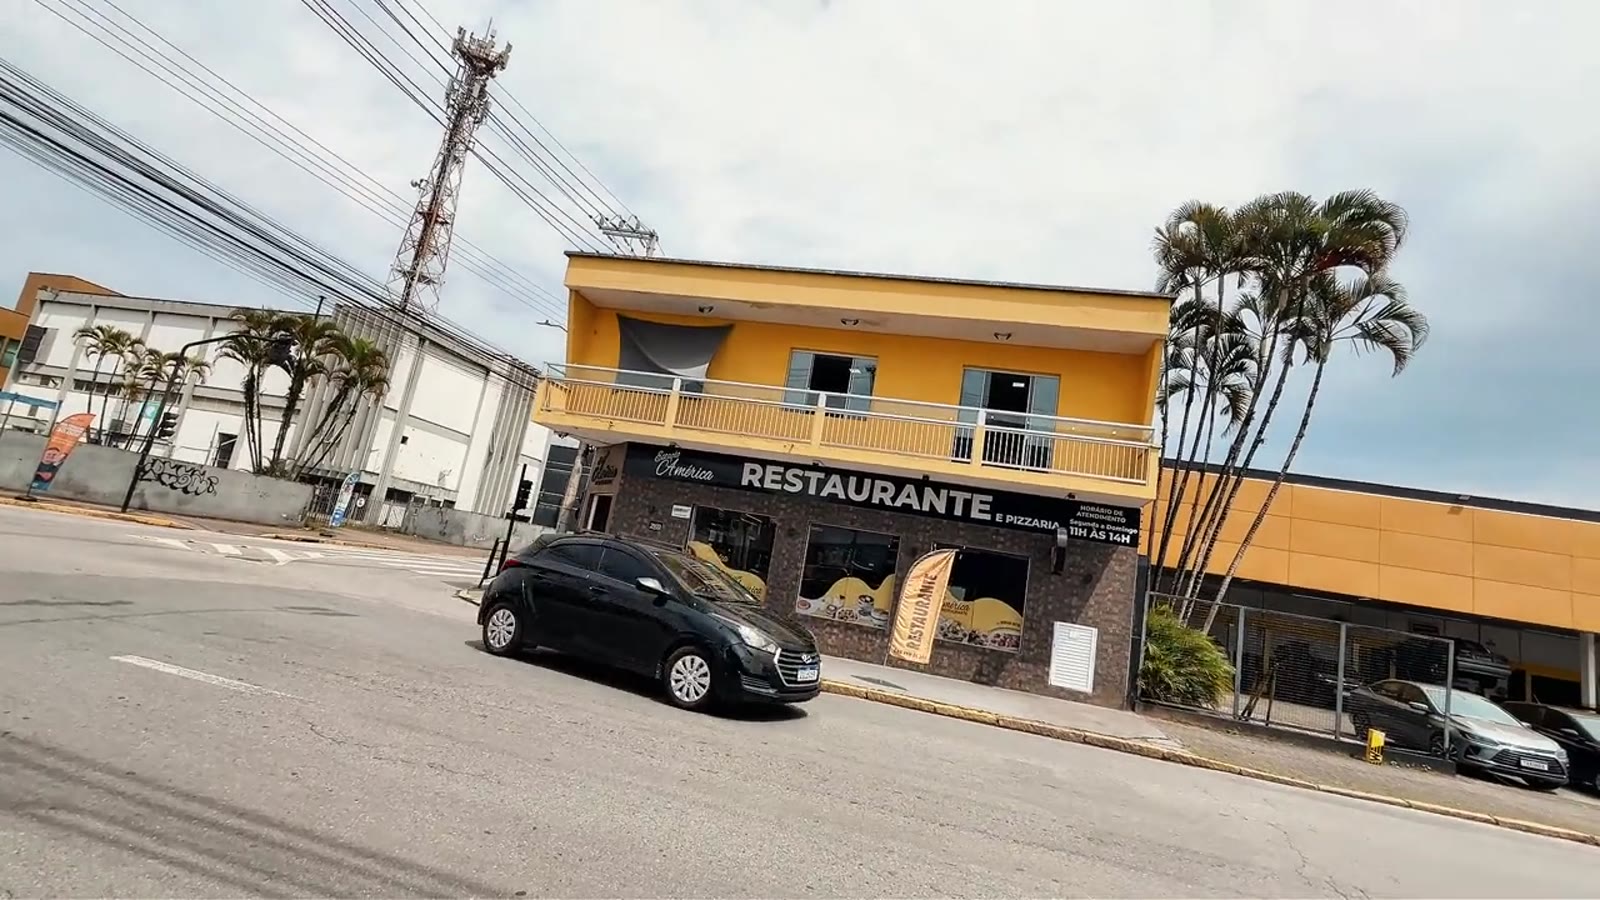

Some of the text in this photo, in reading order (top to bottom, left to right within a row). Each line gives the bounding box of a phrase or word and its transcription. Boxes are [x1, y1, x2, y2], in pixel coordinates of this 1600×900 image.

[656, 459, 714, 481] América
[741, 463, 993, 520] RESTAURANTE
[1076, 511, 1126, 523] ATENDIMENTO
[1080, 505, 1112, 515] HORÁRIO
[995, 513, 1060, 530] E PIZZARIA
[1069, 518, 1099, 528] Segunda
[1106, 524, 1138, 534] Domingo
[1069, 526, 1131, 544] 11H ÀS 14H
[906, 573, 938, 651] RESTAURANTE
